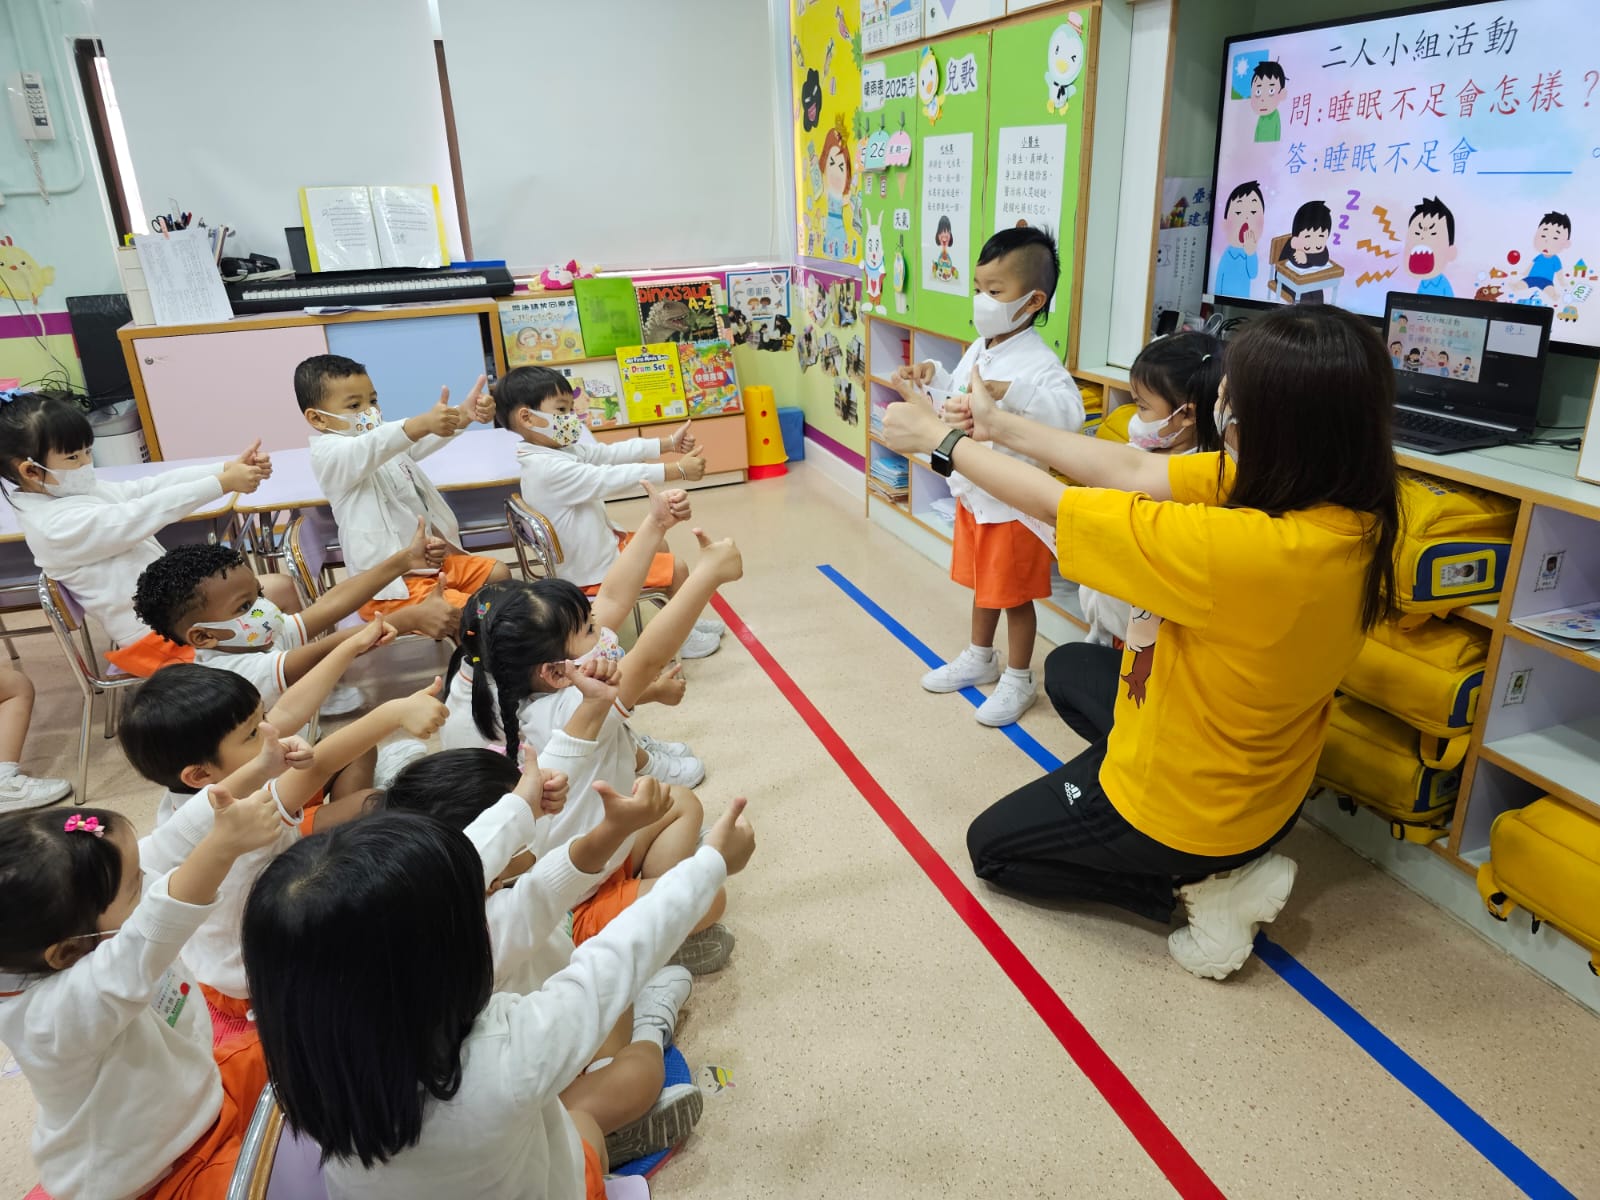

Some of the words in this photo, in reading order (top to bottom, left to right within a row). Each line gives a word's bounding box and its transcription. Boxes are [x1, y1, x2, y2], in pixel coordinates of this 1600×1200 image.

[1321, 15, 1519, 69] 二人小組活動
[945, 58, 976, 92] 兒歌
[885, 77, 916, 99] 2025年
[870, 143, 885, 158] 26
[638, 285, 711, 303] Dinosaur
[688, 296, 713, 309] A-Z
[632, 366, 650, 374] Drum
[653, 363, 666, 371] Set
